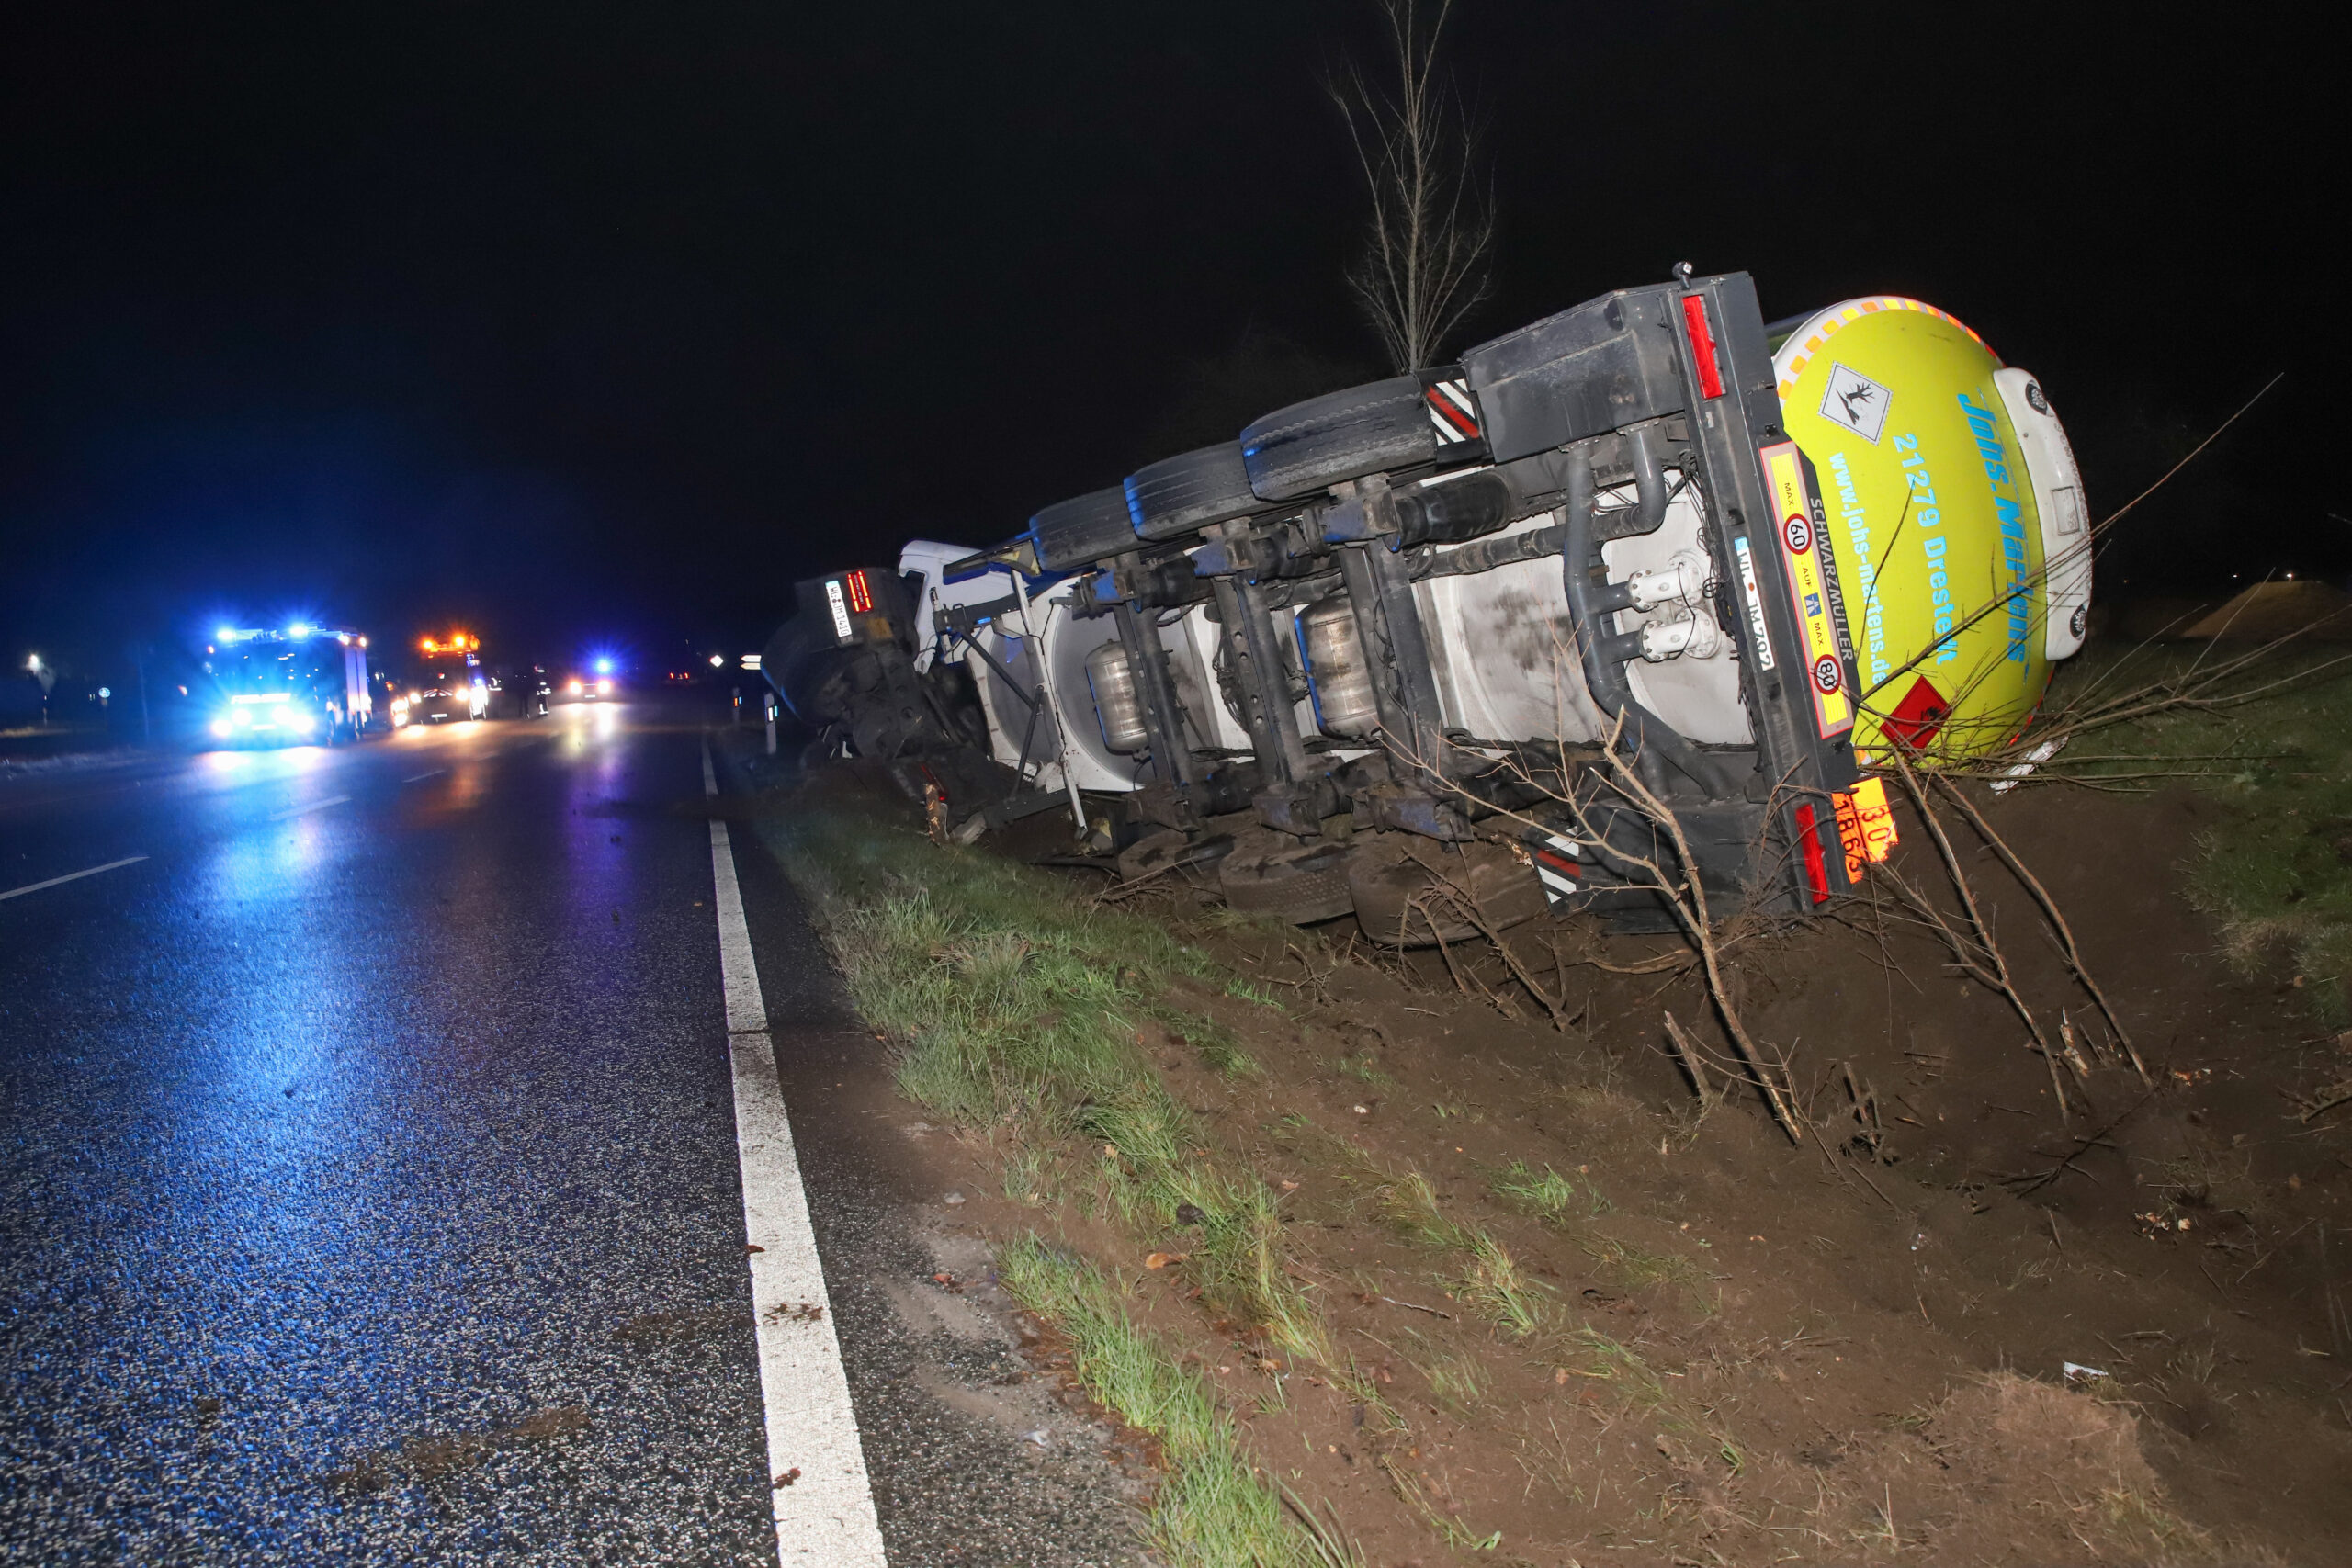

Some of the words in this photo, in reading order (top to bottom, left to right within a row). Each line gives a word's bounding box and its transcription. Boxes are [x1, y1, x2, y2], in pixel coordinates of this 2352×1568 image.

[1893, 433, 1940, 528] 21279
[1957, 393, 2009, 493] Johs.
[1994, 495, 2034, 663] Martens
[1790, 524, 1806, 547] 60
[1820, 662, 1836, 687] 80
[1810, 497, 1854, 660] SCHWARZMÜLLER
[1829, 452, 1891, 684] www.johs-martens.de
[1861, 807, 1891, 842] 30
